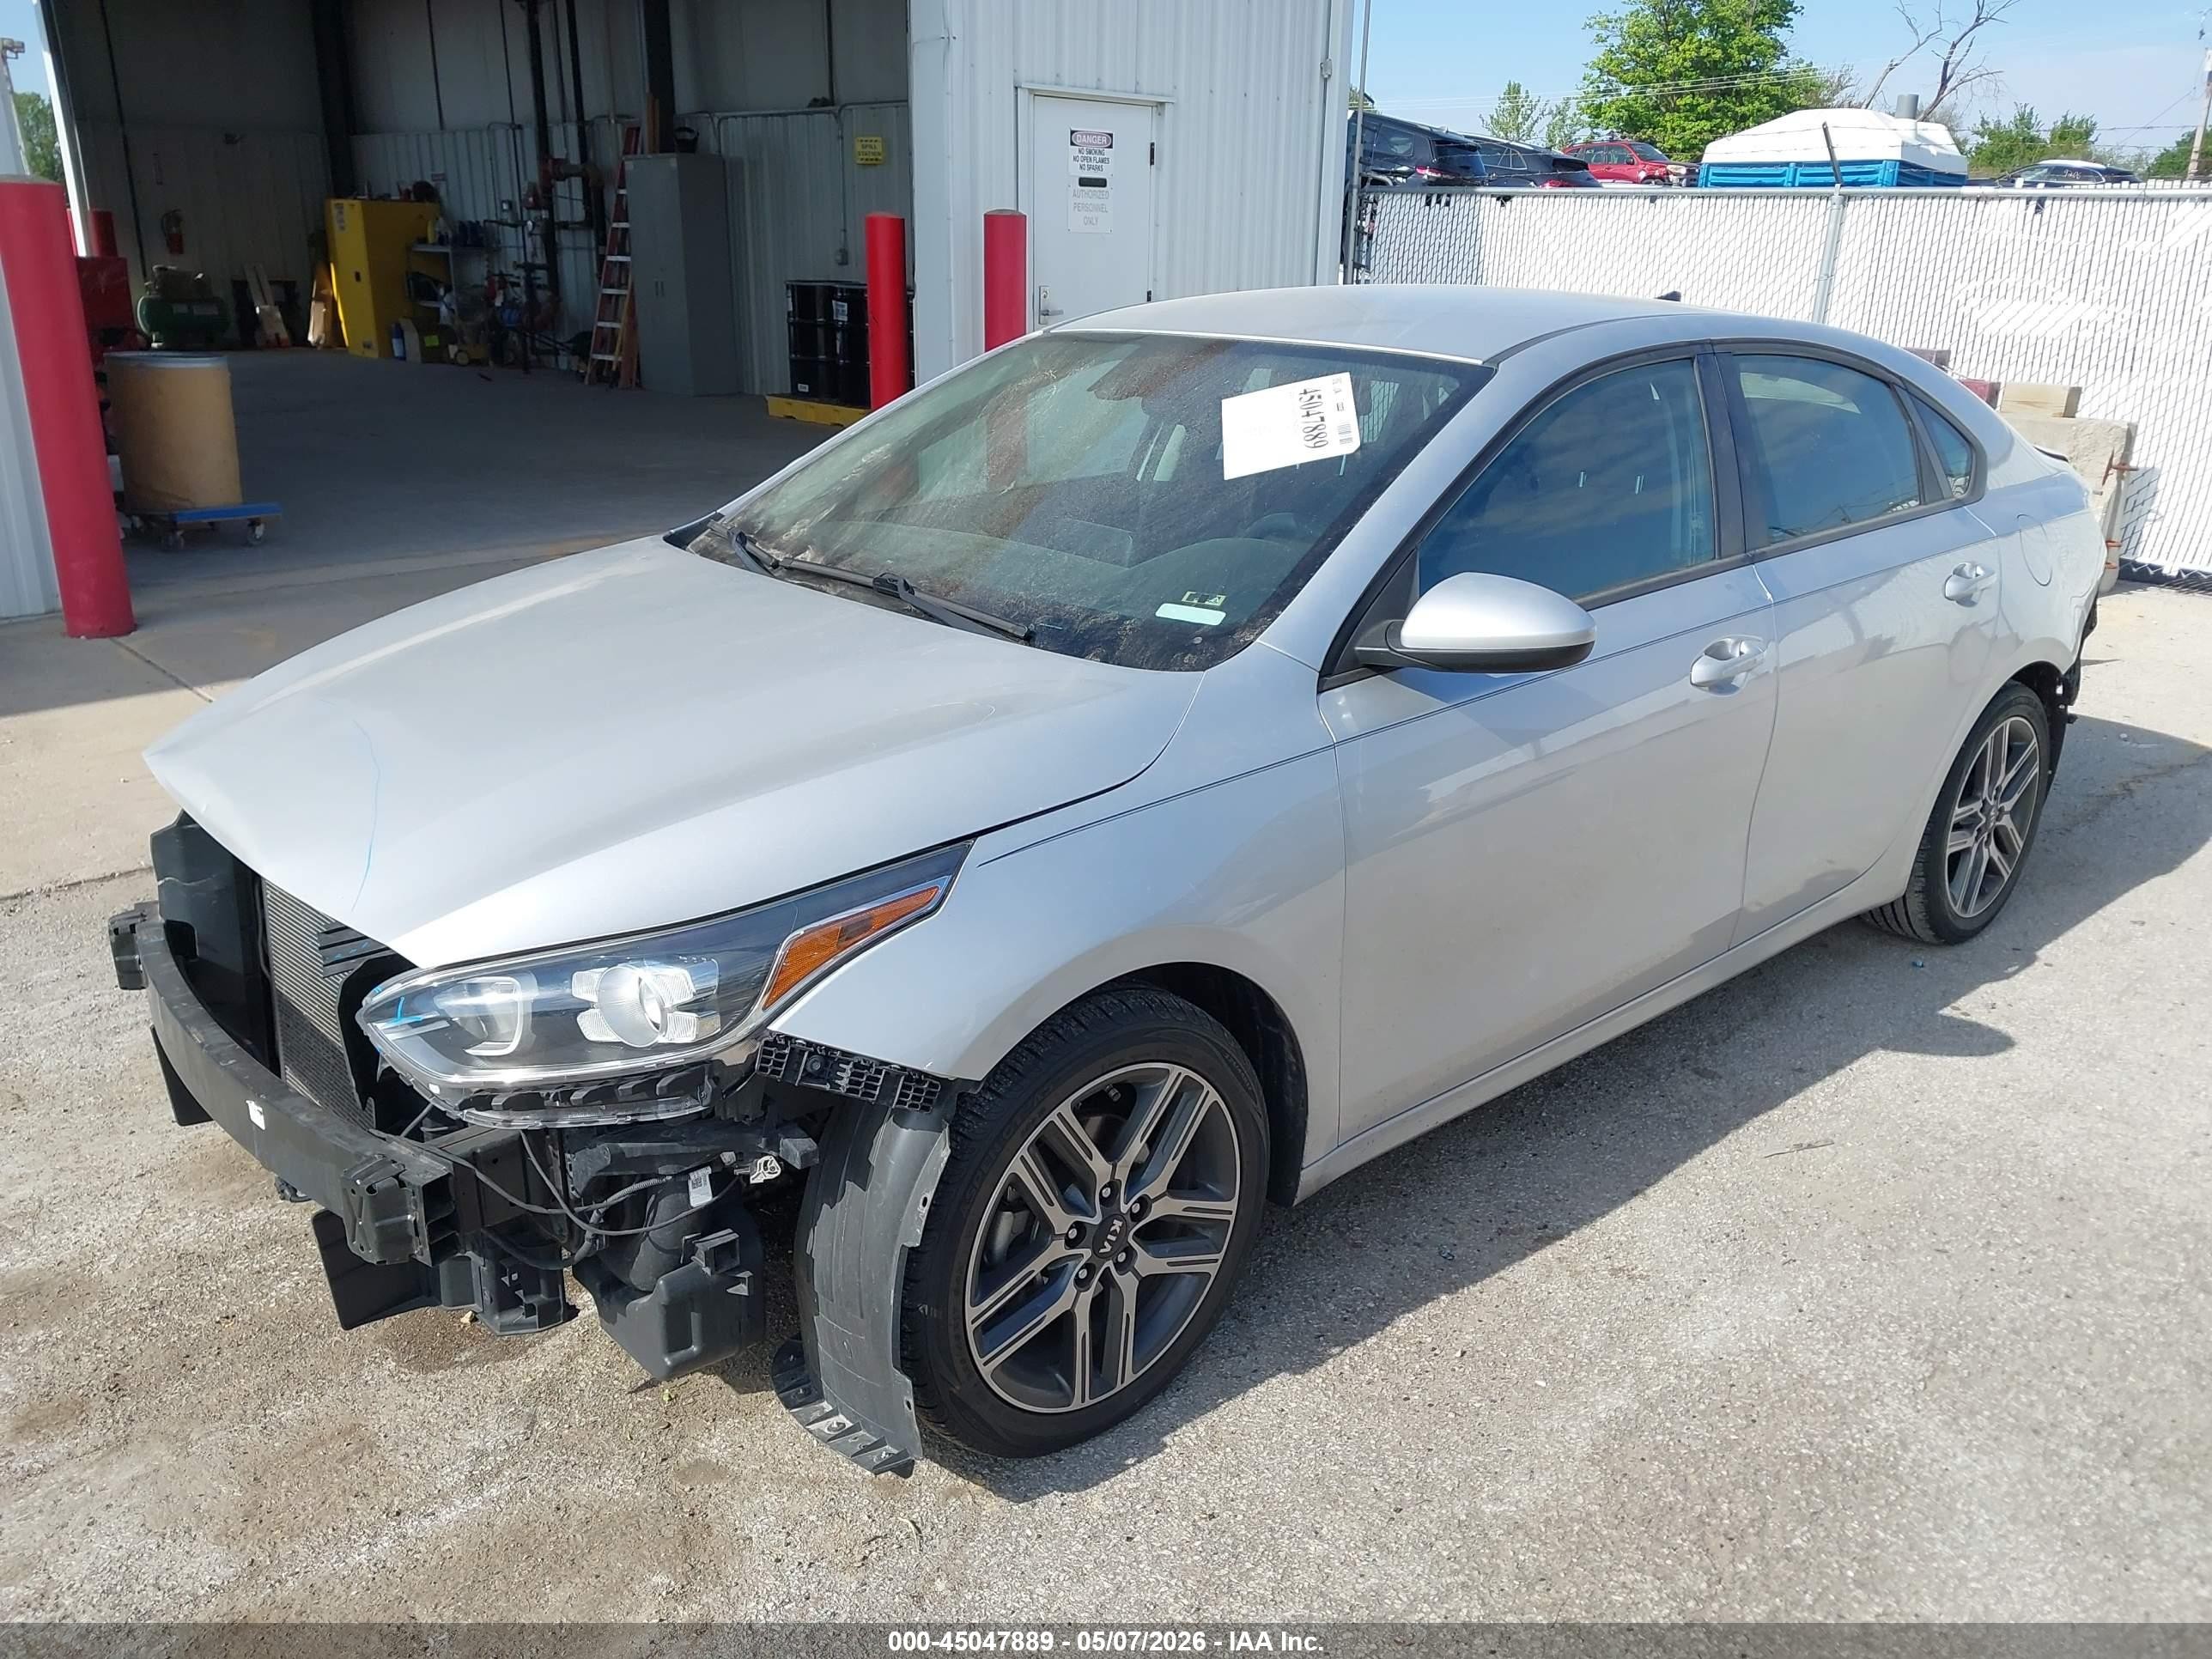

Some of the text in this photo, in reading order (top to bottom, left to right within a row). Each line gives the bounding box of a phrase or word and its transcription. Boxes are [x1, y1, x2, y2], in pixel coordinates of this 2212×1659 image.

[1076, 135, 1107, 145] DANGER
[1073, 189, 1109, 200] AUTHORIZED
[1073, 203, 1109, 213] PERSONNEL
[1083, 216, 1099, 226] ONLY
[1298, 388, 1329, 449] 45047889
[1098, 1219, 1123, 1254] KIA
